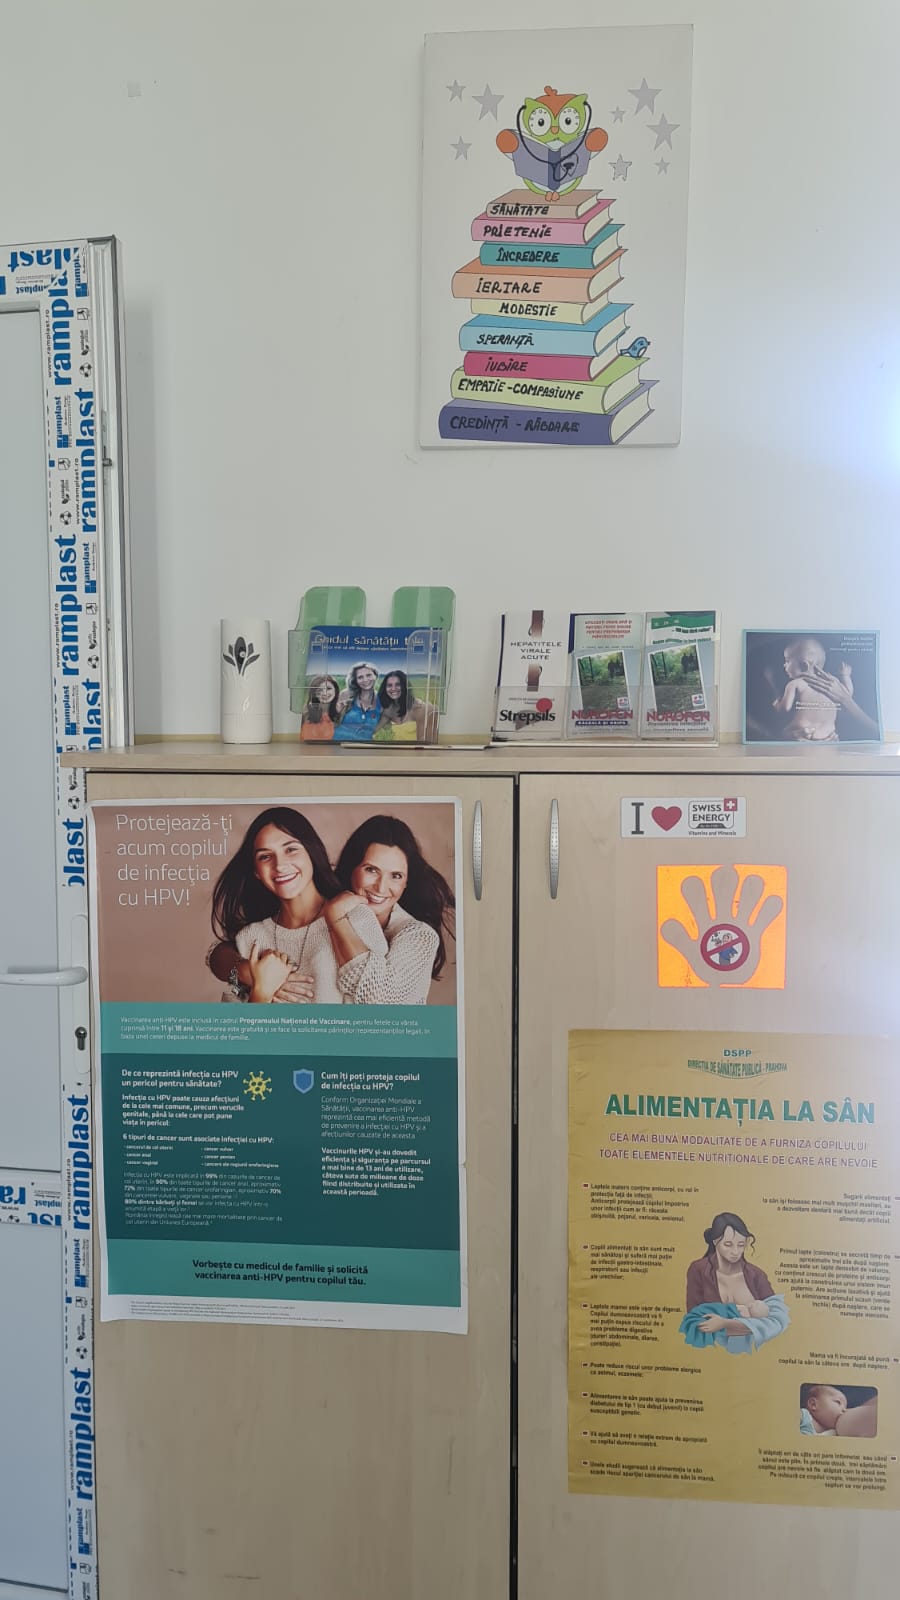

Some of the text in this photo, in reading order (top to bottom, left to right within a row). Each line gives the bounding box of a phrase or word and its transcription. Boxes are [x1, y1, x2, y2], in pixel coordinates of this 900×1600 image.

[498, 303, 558, 316] MODESTIE
[55, 534, 82, 676] ramplast
[499, 709, 556, 725] Strepsils
[571, 710, 633, 720] NUROFEN
[646, 711, 710, 721] NUROFEN
[631, 802, 722, 835] I SWISS
[692, 813, 731, 822] ENERGY
[116, 839, 227, 860] acum copilul
[117, 863, 140, 881] de
[118, 888, 190, 906] cu HPV!
[723, 1049, 752, 1057] DSPP
[122, 1069, 131, 1077] De
[143, 1070, 180, 1079] reprezintă
[321, 1072, 338, 1080] Cum
[366, 1073, 393, 1082] proteja
[395, 1073, 419, 1082] copilul
[159, 1080, 184, 1088] pentru
[172, 1095, 190, 1103] poate
[123, 1111, 150, 1119] genitale,
[604, 1093, 875, 1128] ALIMENTAȚIA LA SÂN
[129, 1134, 146, 1142] tipuri
[610, 1133, 629, 1142] CEA
[632, 1134, 649, 1143] MAI
[681, 1135, 741, 1146] MODALITATE
[745, 1137, 758, 1147] DE
[761, 1138, 767, 1147] A
[770, 1138, 811, 1149] FURNIZA
[814, 1139, 867, 1151] COPILULUI
[322, 1147, 357, 1155] Vaccinurile
[68, 1094, 93, 1230] ramplast
[600, 1149, 629, 1159] TOATE
[632, 1150, 695, 1162] ELEMENTELE
[772, 1155, 784, 1165] DE
[788, 1156, 815, 1166] CARE
[818, 1157, 837, 1167] ARE
[841, 1158, 877, 1169] NEVOIE
[192, 1260, 368, 1275] Vorbește cu medicul de familie și solicită
[195, 1272, 366, 1286] vaccinarea anti-HPV pentru copilul tău.
[70, 1367, 95, 1501] ramplast
